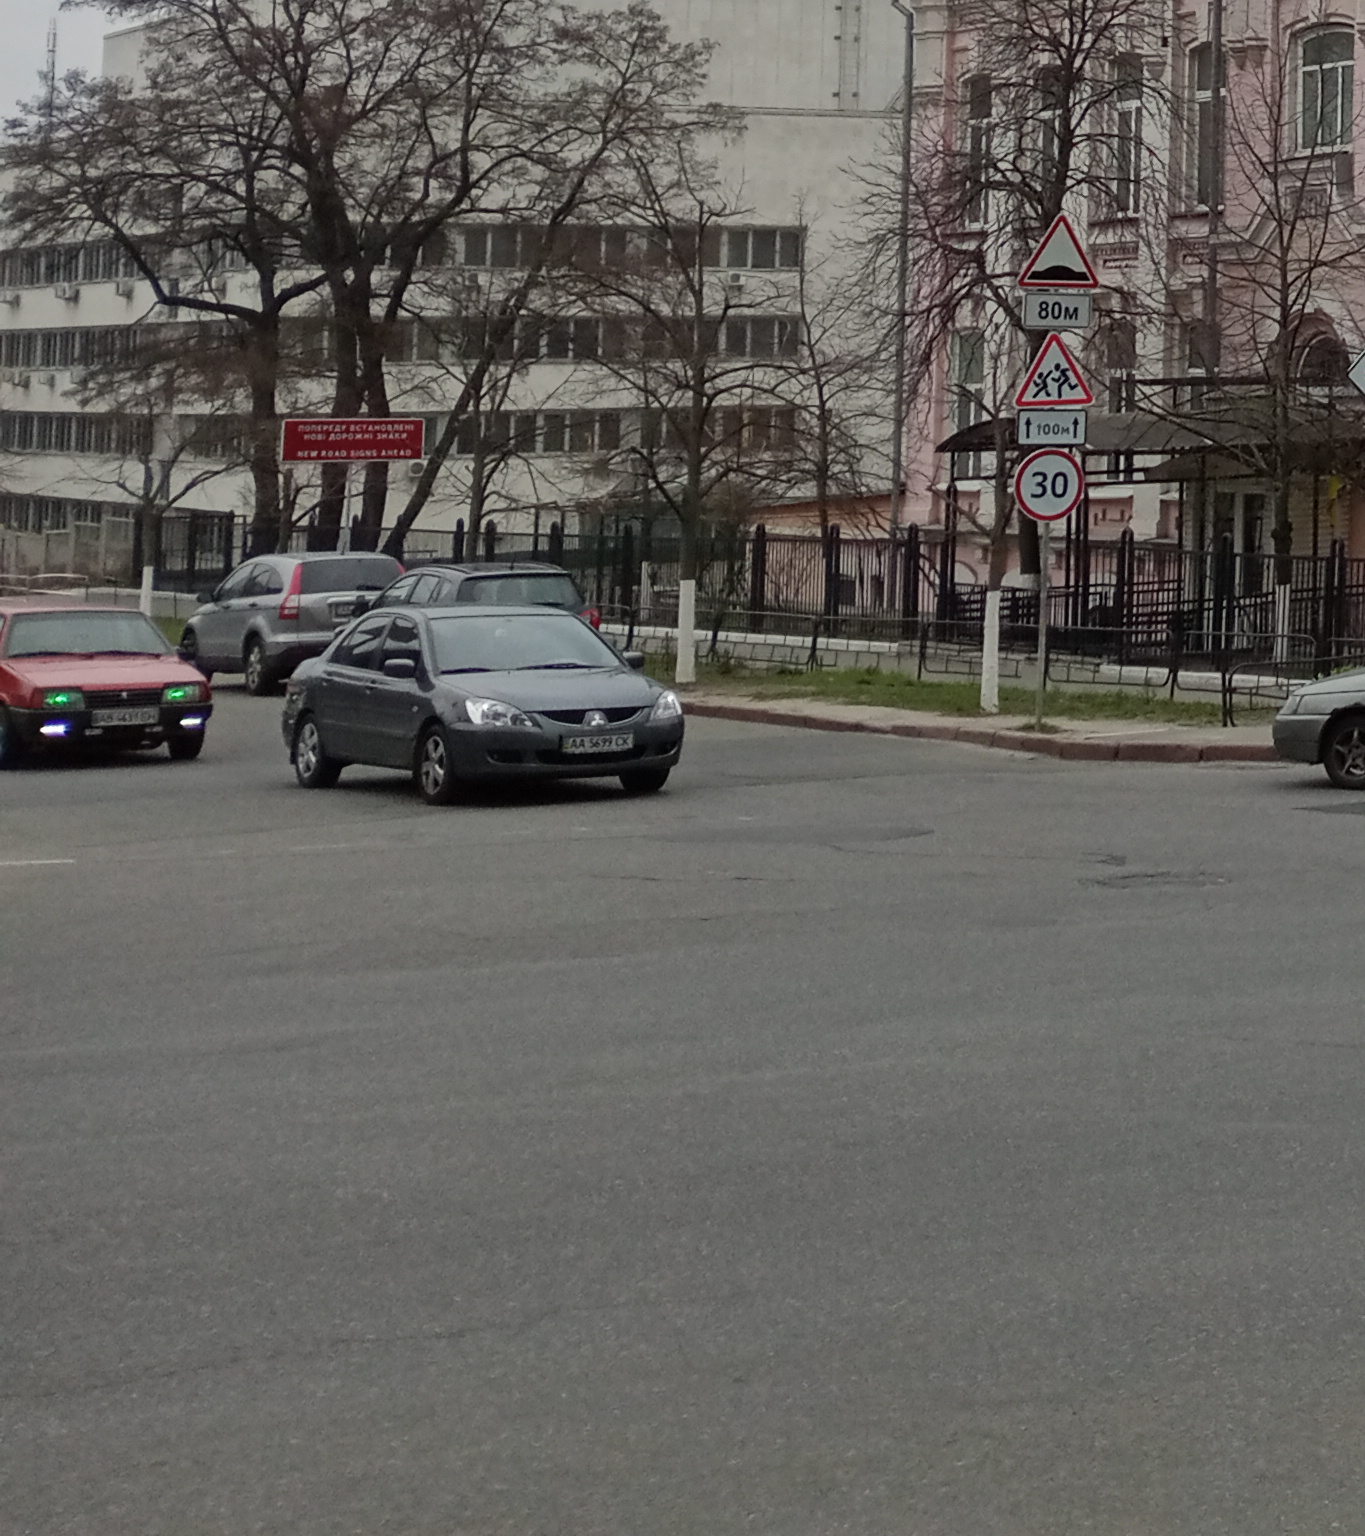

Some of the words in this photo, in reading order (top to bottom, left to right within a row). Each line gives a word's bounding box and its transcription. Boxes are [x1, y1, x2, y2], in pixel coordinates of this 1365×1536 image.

[298, 424, 347, 432] ПОПЕРЕДУ
[304, 433, 326, 441] НОВІ
[328, 432, 373, 441] ДОРОЖНІ
[377, 432, 408, 440] ЗНАКИ
[350, 449, 378, 457] SIGNS
[381, 449, 412, 457] AHEAD
[1030, 471, 1069, 499] 30
[570, 738, 585, 749] AA
